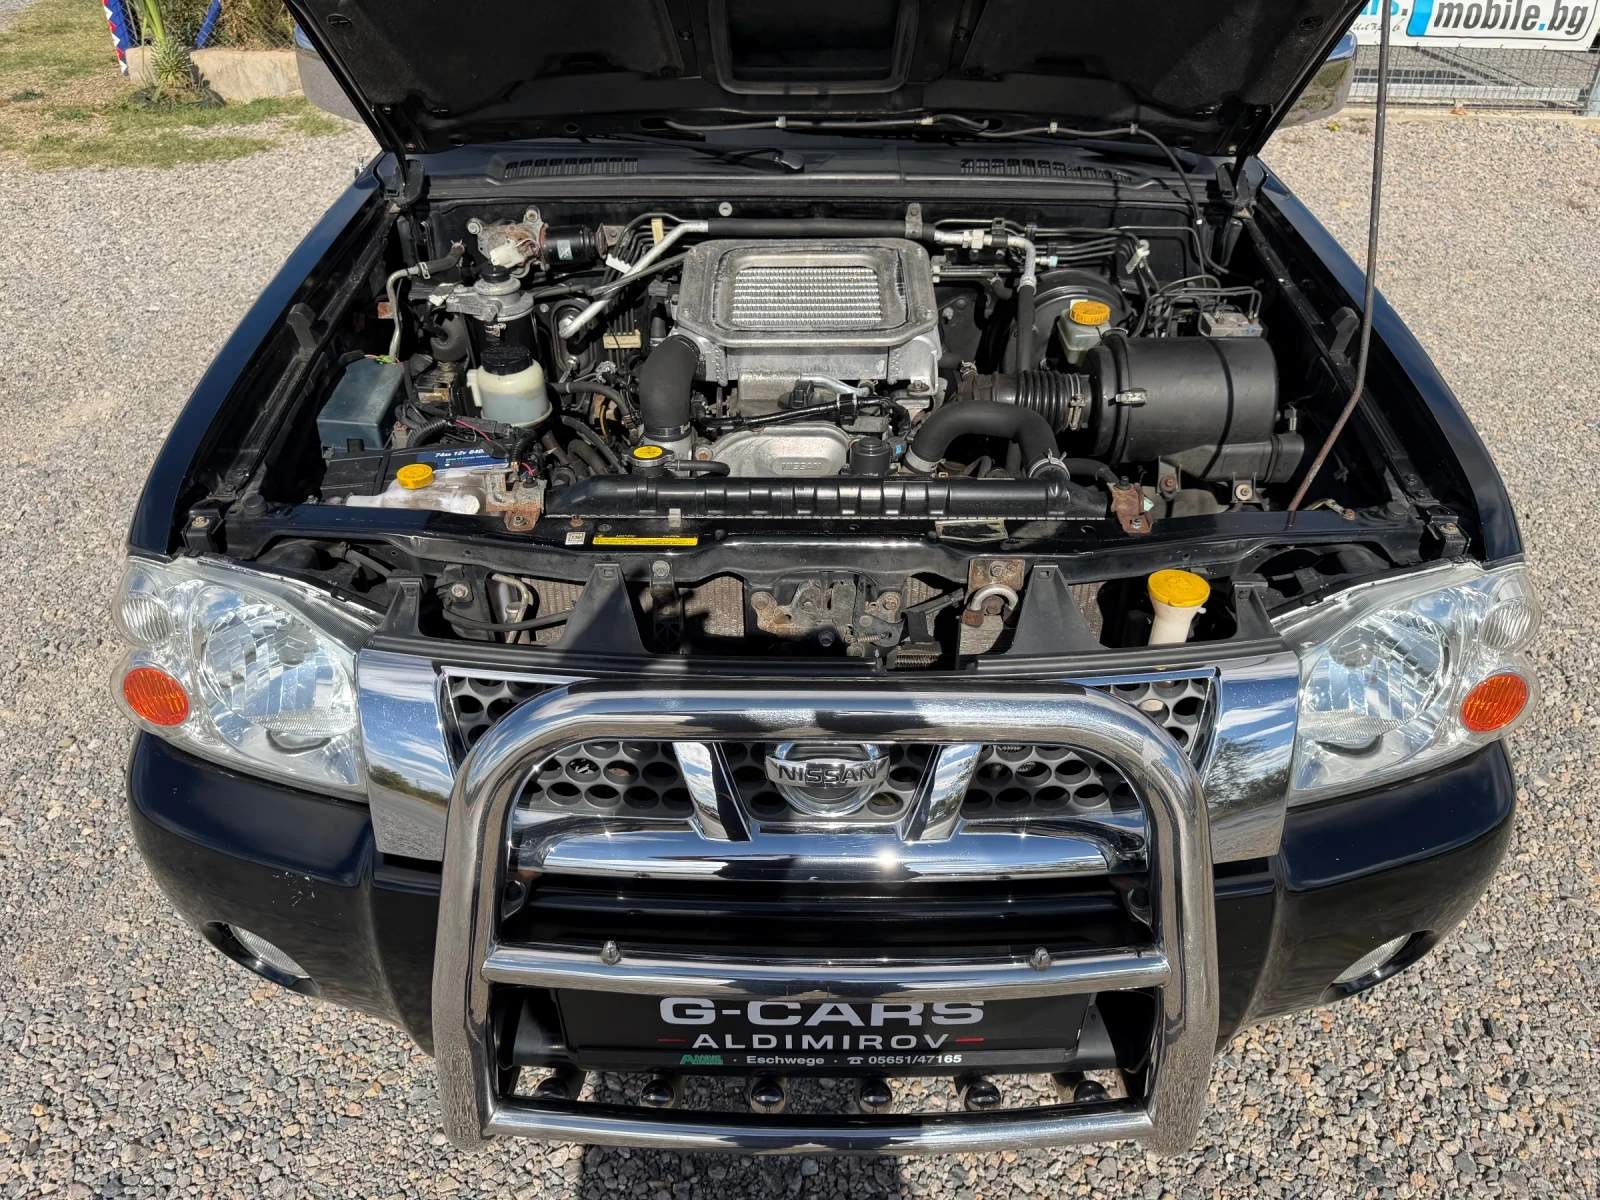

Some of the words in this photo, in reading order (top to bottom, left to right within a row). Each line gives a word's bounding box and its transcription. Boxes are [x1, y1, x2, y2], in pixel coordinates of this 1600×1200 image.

[1433, 0, 1589, 36] mobile.bg
[781, 462, 822, 471] NISSAN
[778, 764, 877, 783] NISSAN
[659, 997, 984, 1026] G-CARS
[691, 1033, 949, 1050] ALDIMIROV
[746, 1055, 825, 1066] Eschwege
[868, 1054, 962, 1065] 05651/47165
